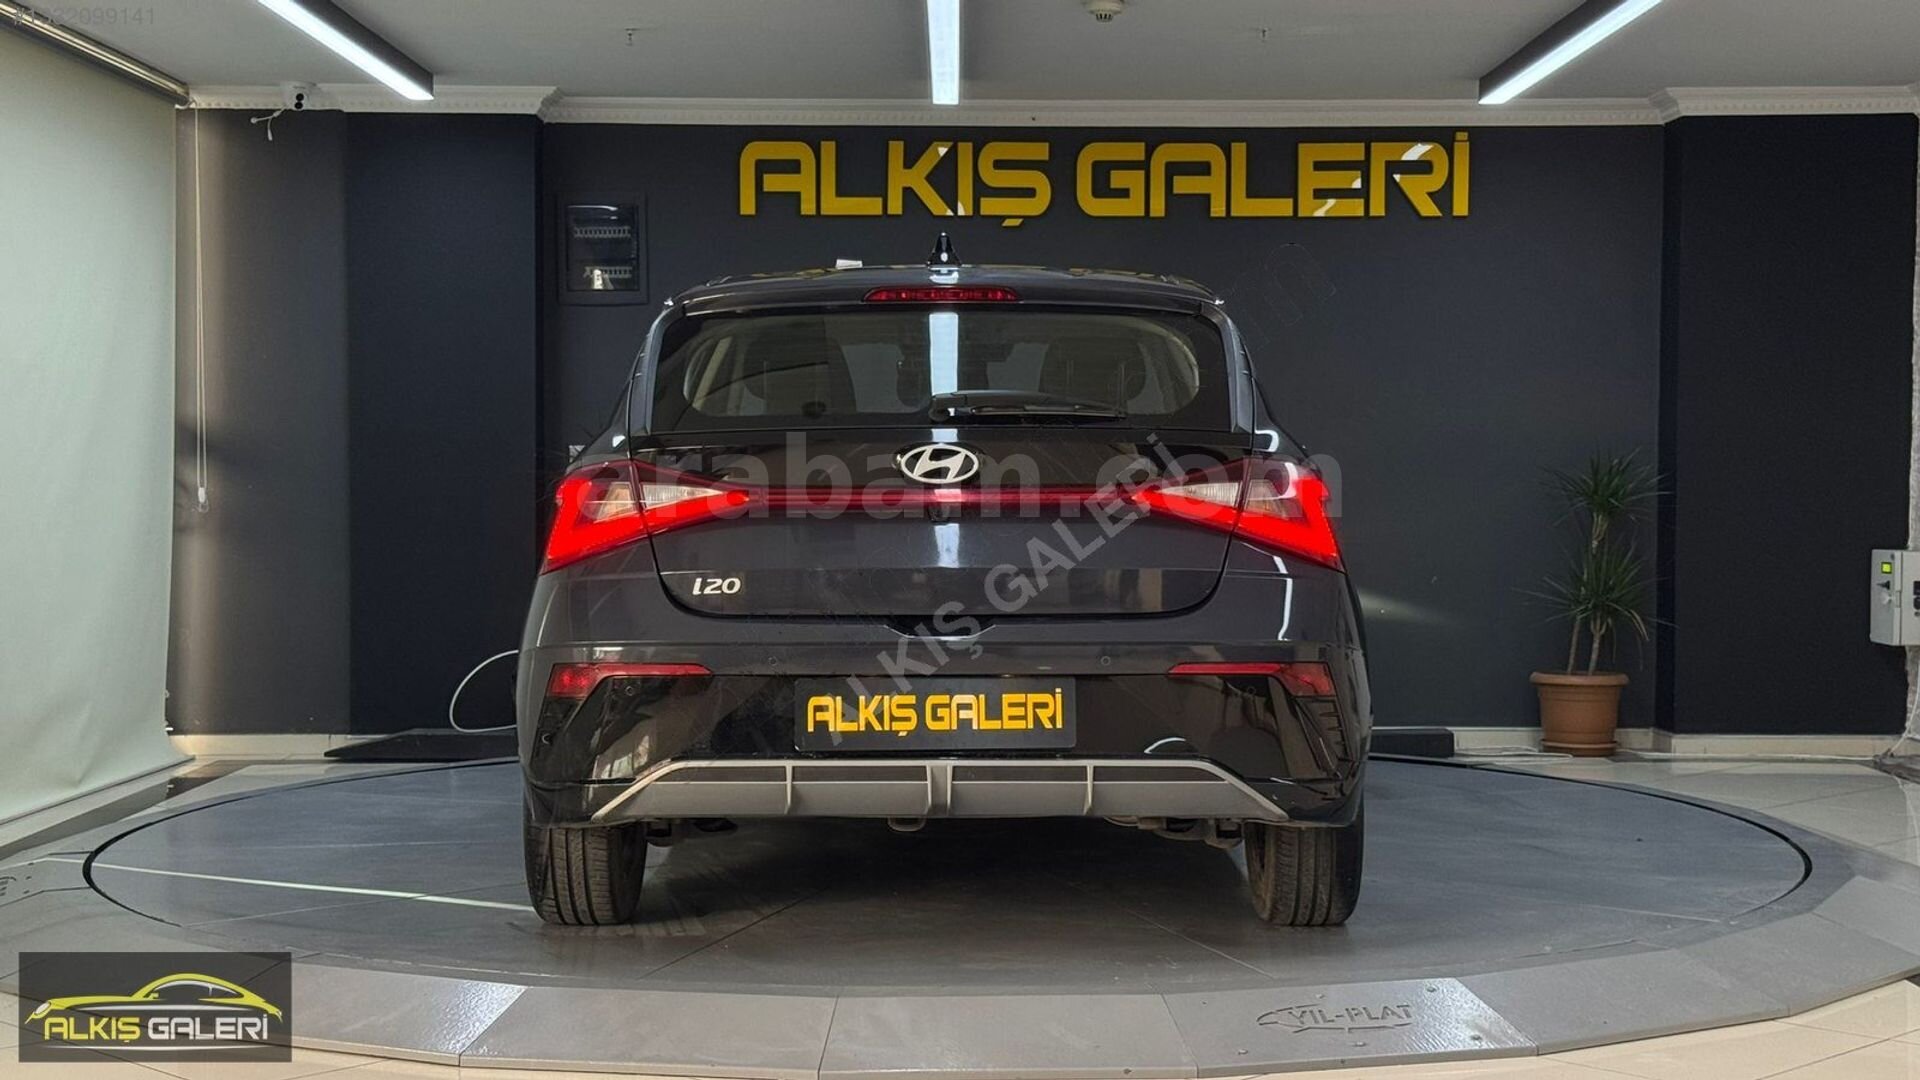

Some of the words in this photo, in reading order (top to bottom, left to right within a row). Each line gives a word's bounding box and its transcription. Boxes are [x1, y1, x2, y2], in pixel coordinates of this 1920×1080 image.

[740, 140, 1051, 227] ALKIŞ
[1076, 132, 1469, 217] GALERİ
[807, 694, 918, 737] ALKIŞ
[925, 688, 1062, 730] GALERİ
